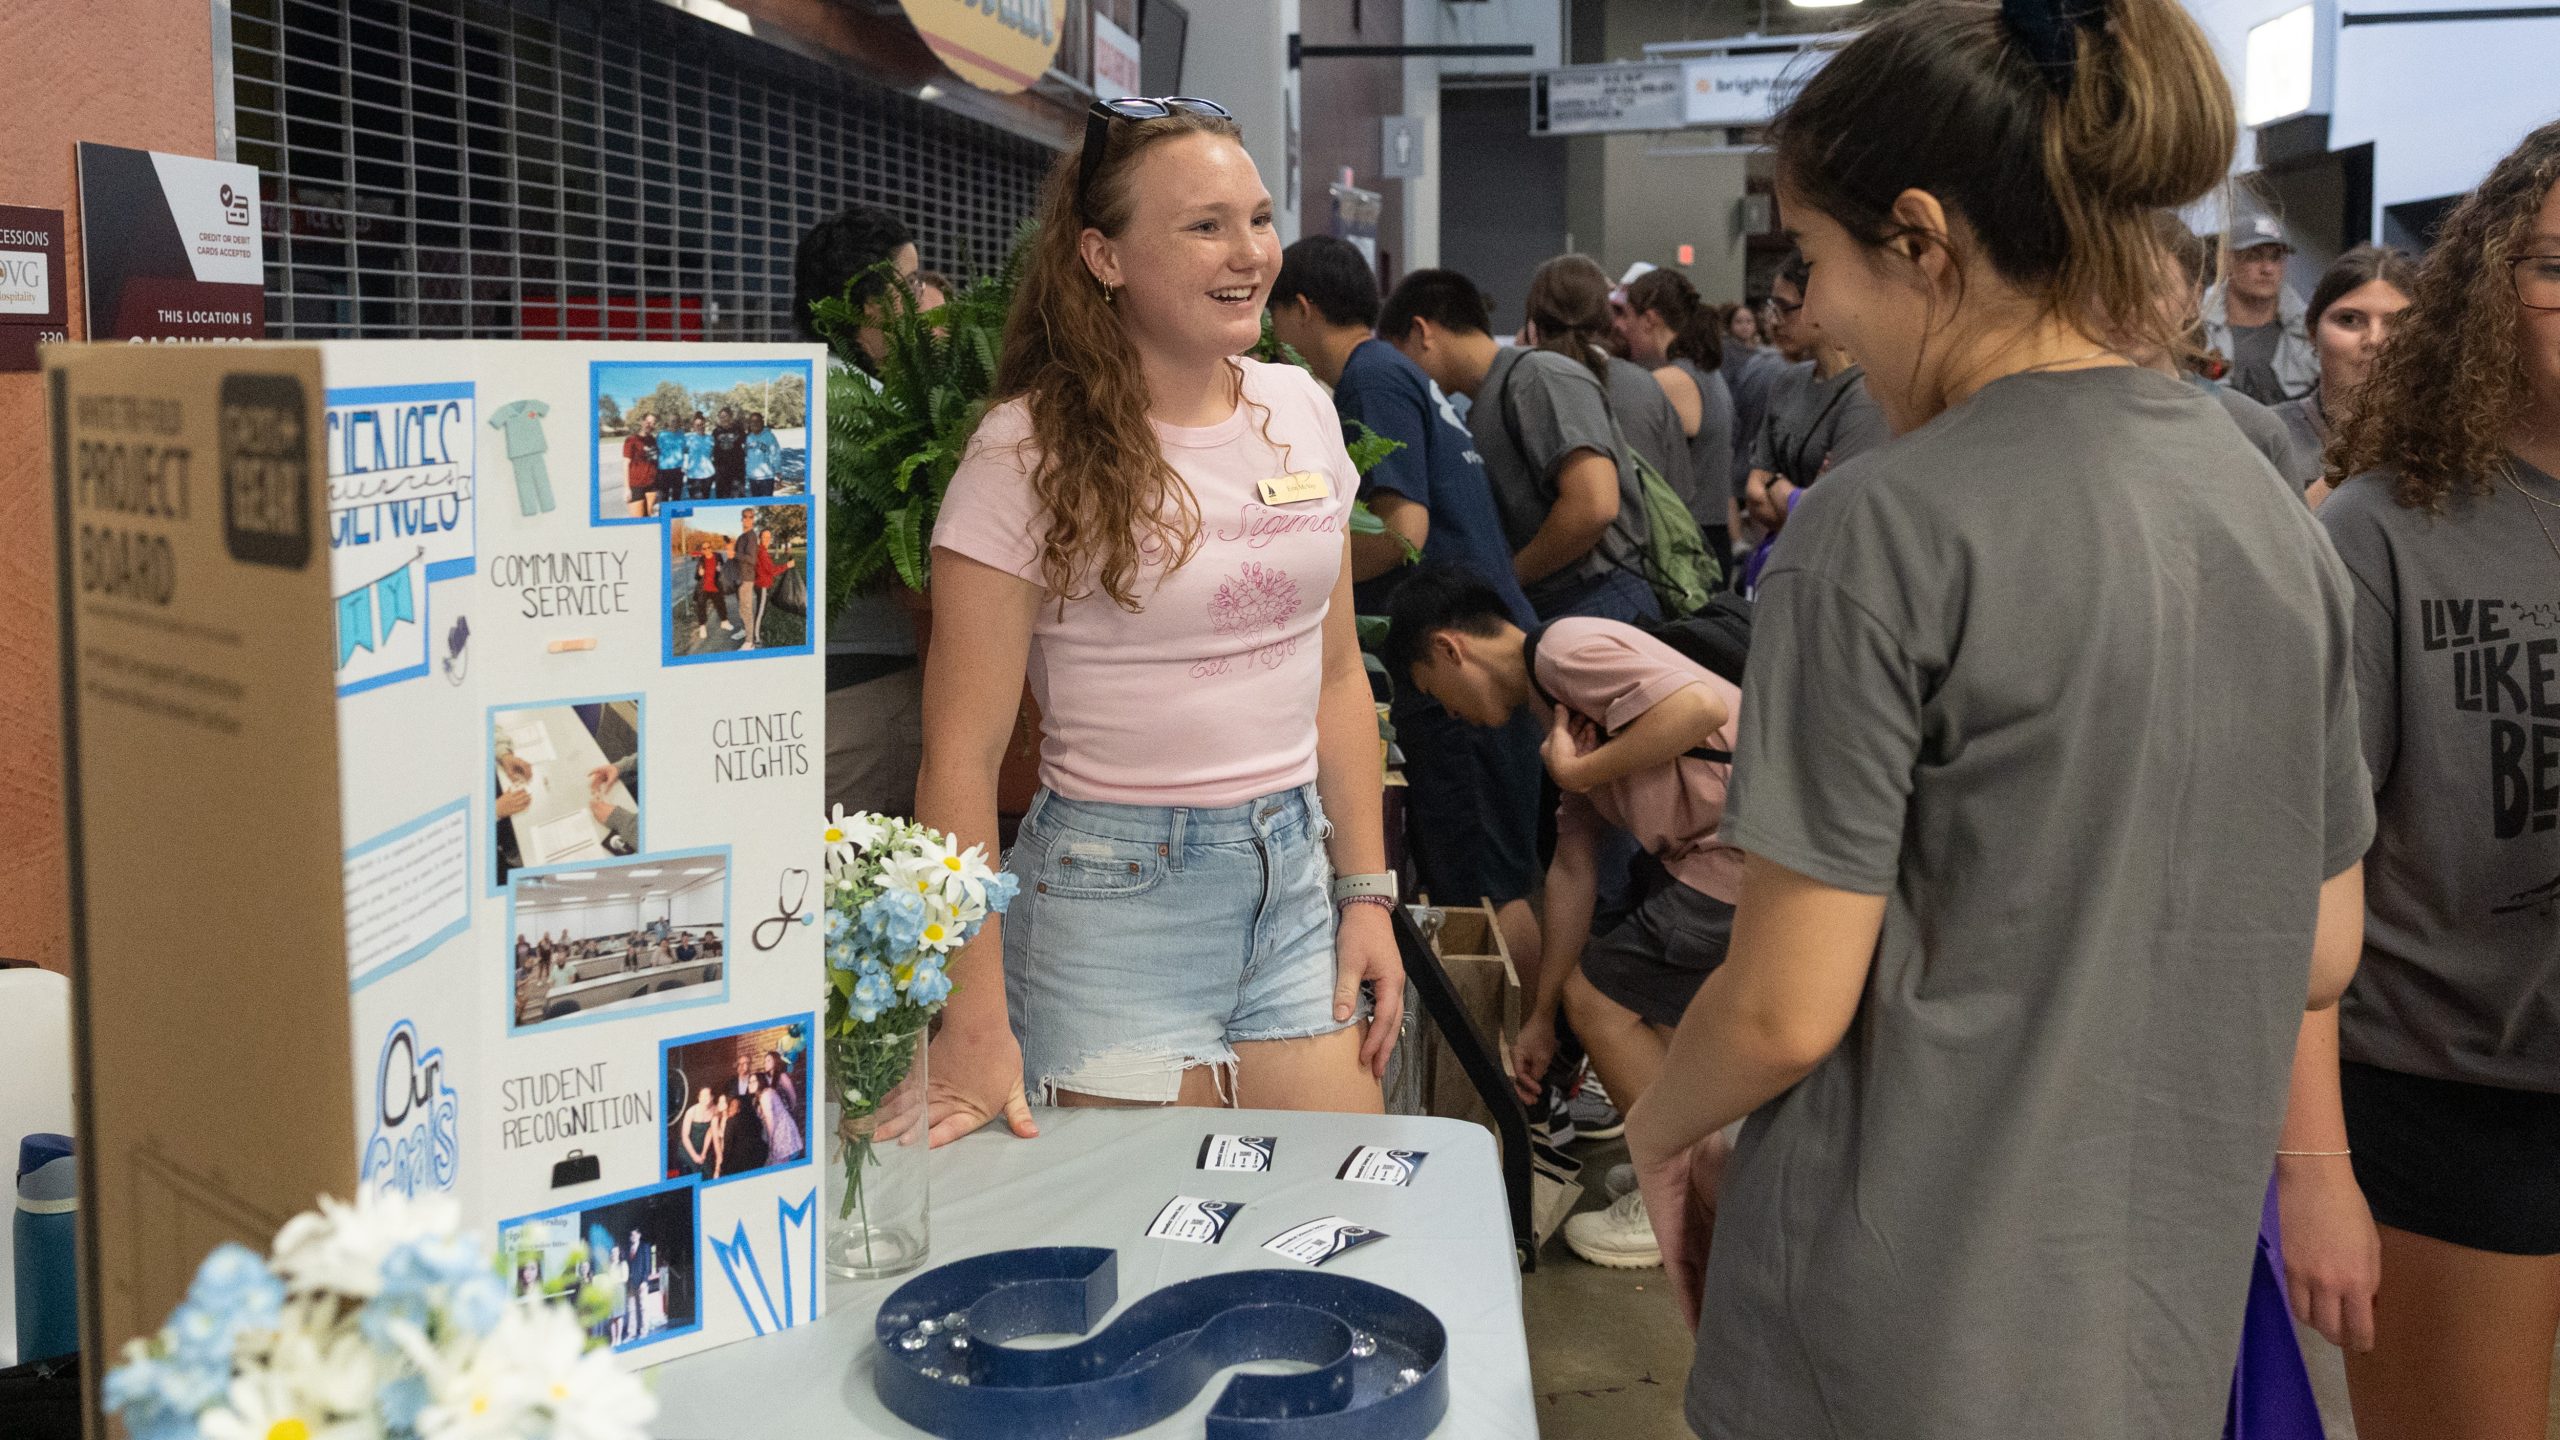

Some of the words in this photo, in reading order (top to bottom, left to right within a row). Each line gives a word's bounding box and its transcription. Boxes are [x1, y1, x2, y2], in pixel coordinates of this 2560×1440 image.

[197, 246, 218, 256] CARDS
[219, 248, 251, 259] ACCEPTED
[199, 232, 221, 243] CREDIT
[222, 234, 231, 244] OR
[232, 235, 251, 245] DEBIT
[0, 290, 36, 304] ospitality
[157, 309, 183, 323] THIS
[186, 311, 240, 325] LOCATION
[242, 312, 253, 325] IS
[1217, 502, 1338, 549] Sigma
[491, 550, 630, 588] COMMUNITY
[522, 582, 630, 619] SERVICE
[2420, 598, 2510, 651] LIVE
[2452, 637, 2560, 721] LIKE
[712, 710, 804, 750] CLINIC
[714, 743, 810, 784] NIGHTS
[382, 1030, 440, 1128] Our
[501, 1061, 608, 1113] STUDENT
[501, 1090, 654, 1151] RECOGNITION
